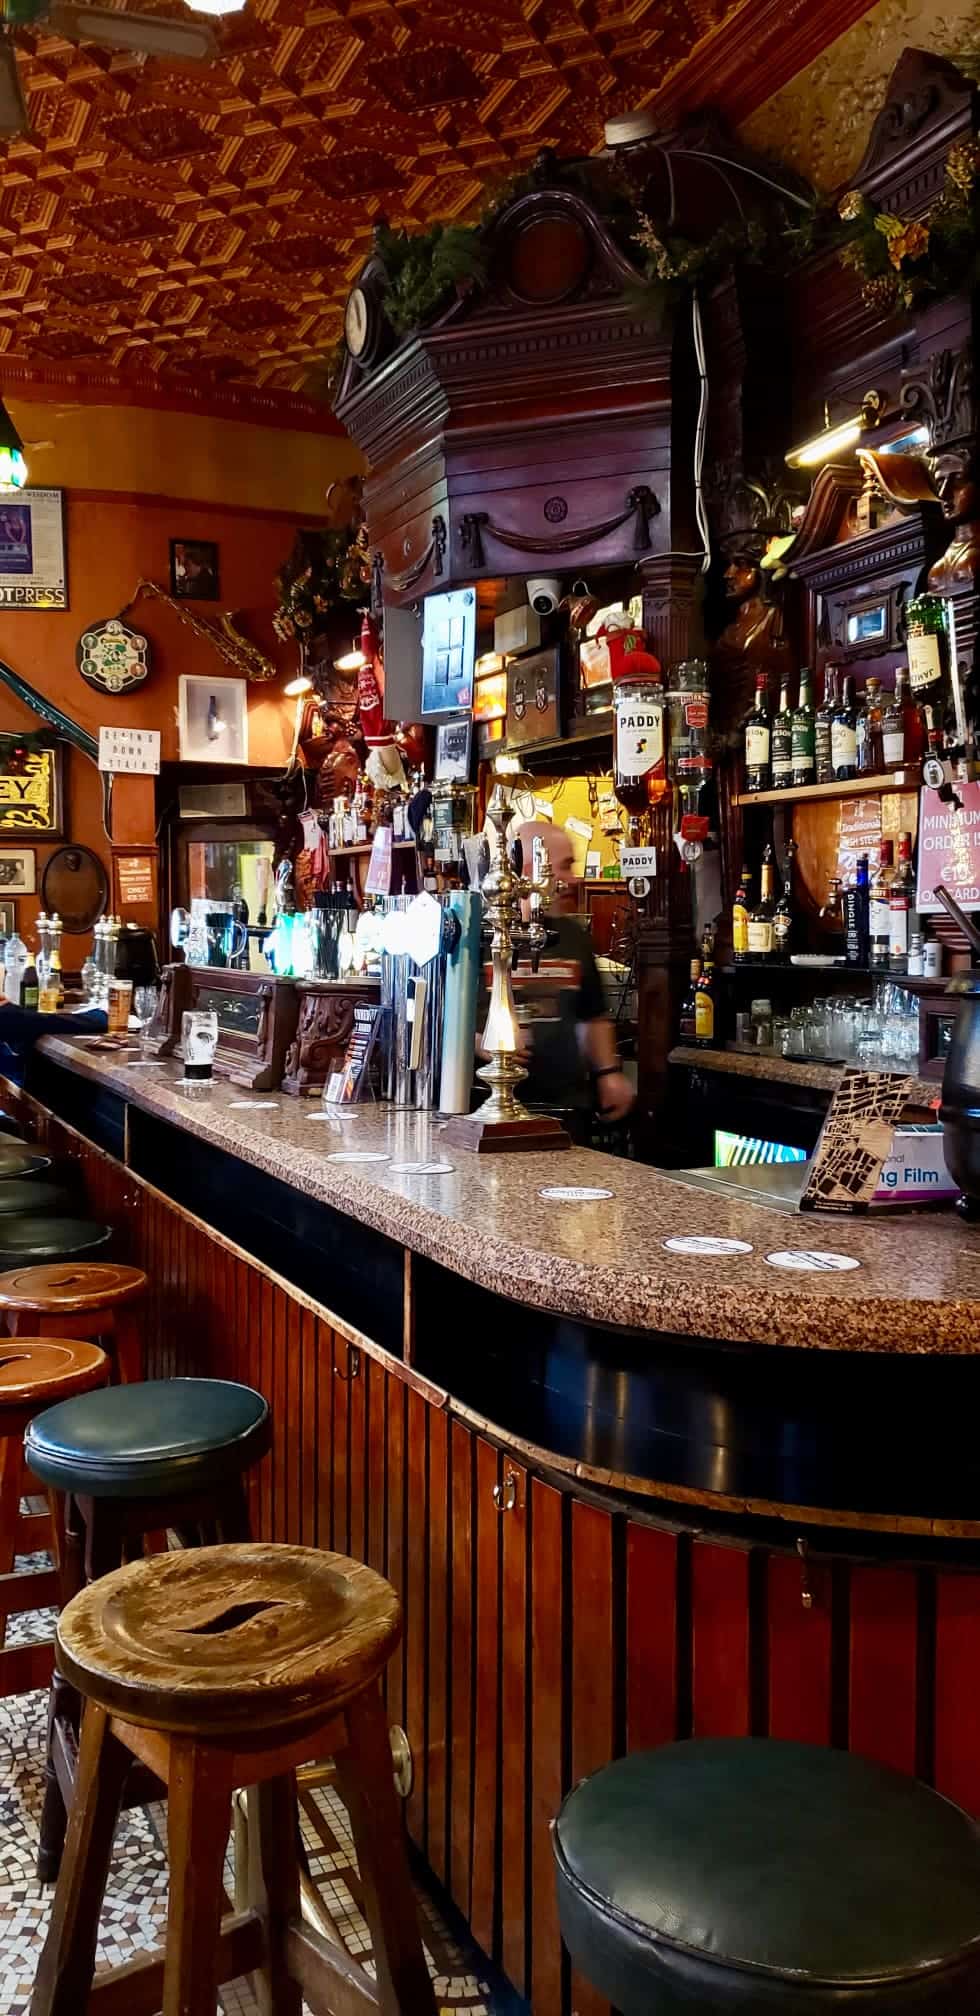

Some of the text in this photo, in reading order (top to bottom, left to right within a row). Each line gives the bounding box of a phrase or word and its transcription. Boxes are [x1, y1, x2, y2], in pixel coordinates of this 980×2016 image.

[620, 715, 660, 728] PADDY
[622, 856, 653, 866] PADDY
[847, 894, 856, 929] DINGLE
[903, 1167, 939, 1183] Film
